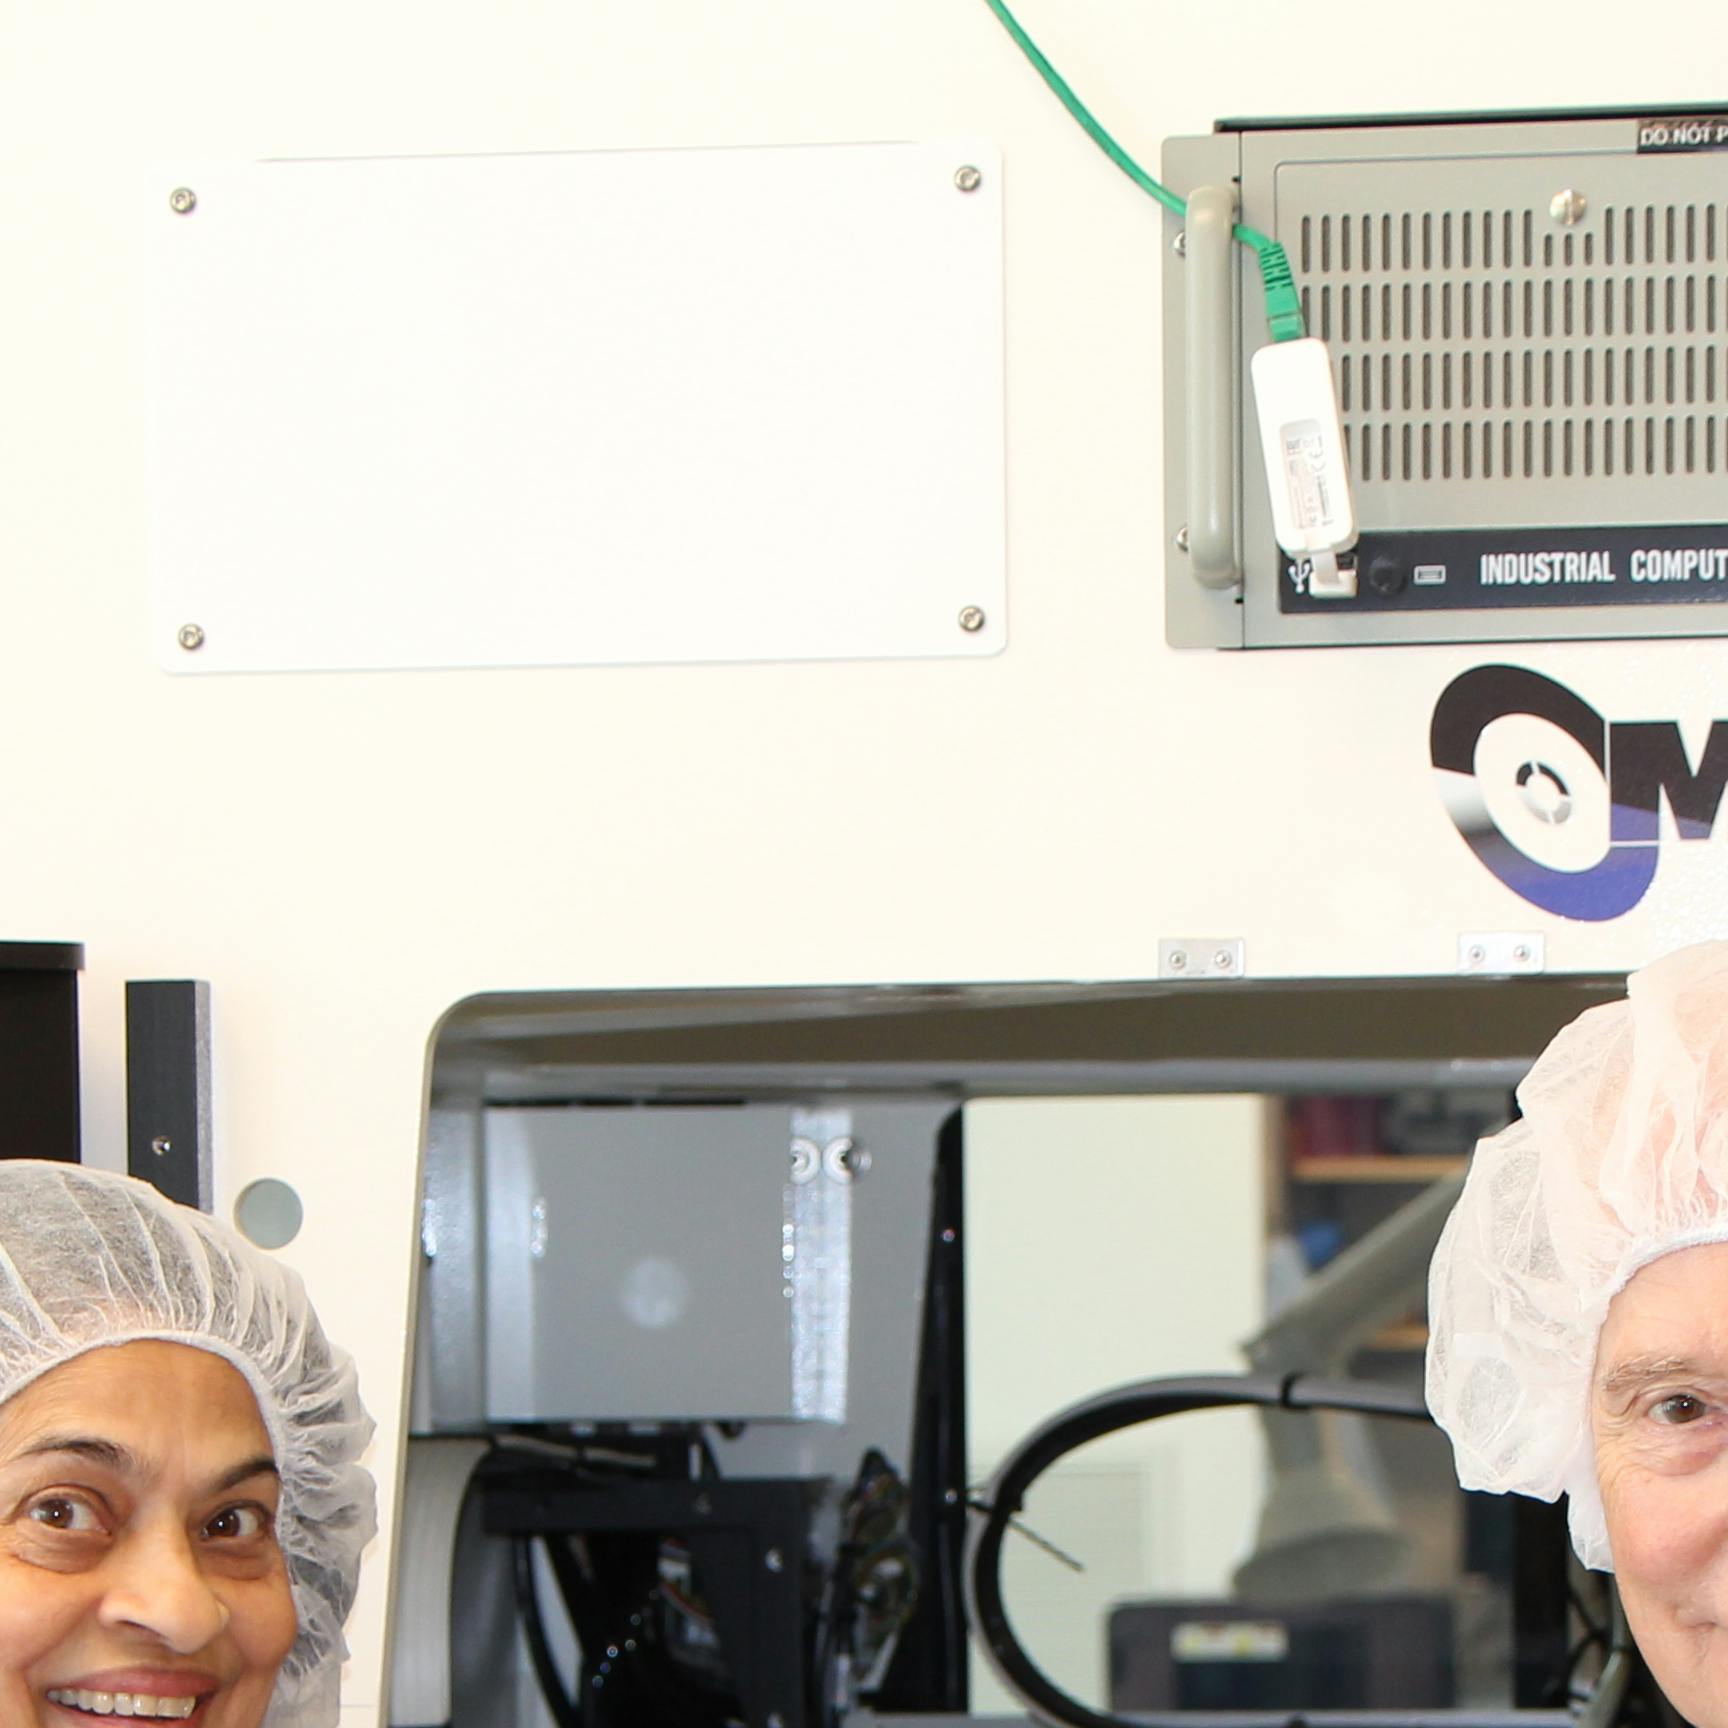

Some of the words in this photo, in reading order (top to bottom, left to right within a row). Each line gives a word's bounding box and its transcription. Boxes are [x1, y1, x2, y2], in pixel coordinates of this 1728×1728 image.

[1640, 127, 1668, 146] DO
[1671, 124, 1710, 145] NOT
[1480, 550, 1616, 586] INDUSTRIAL
